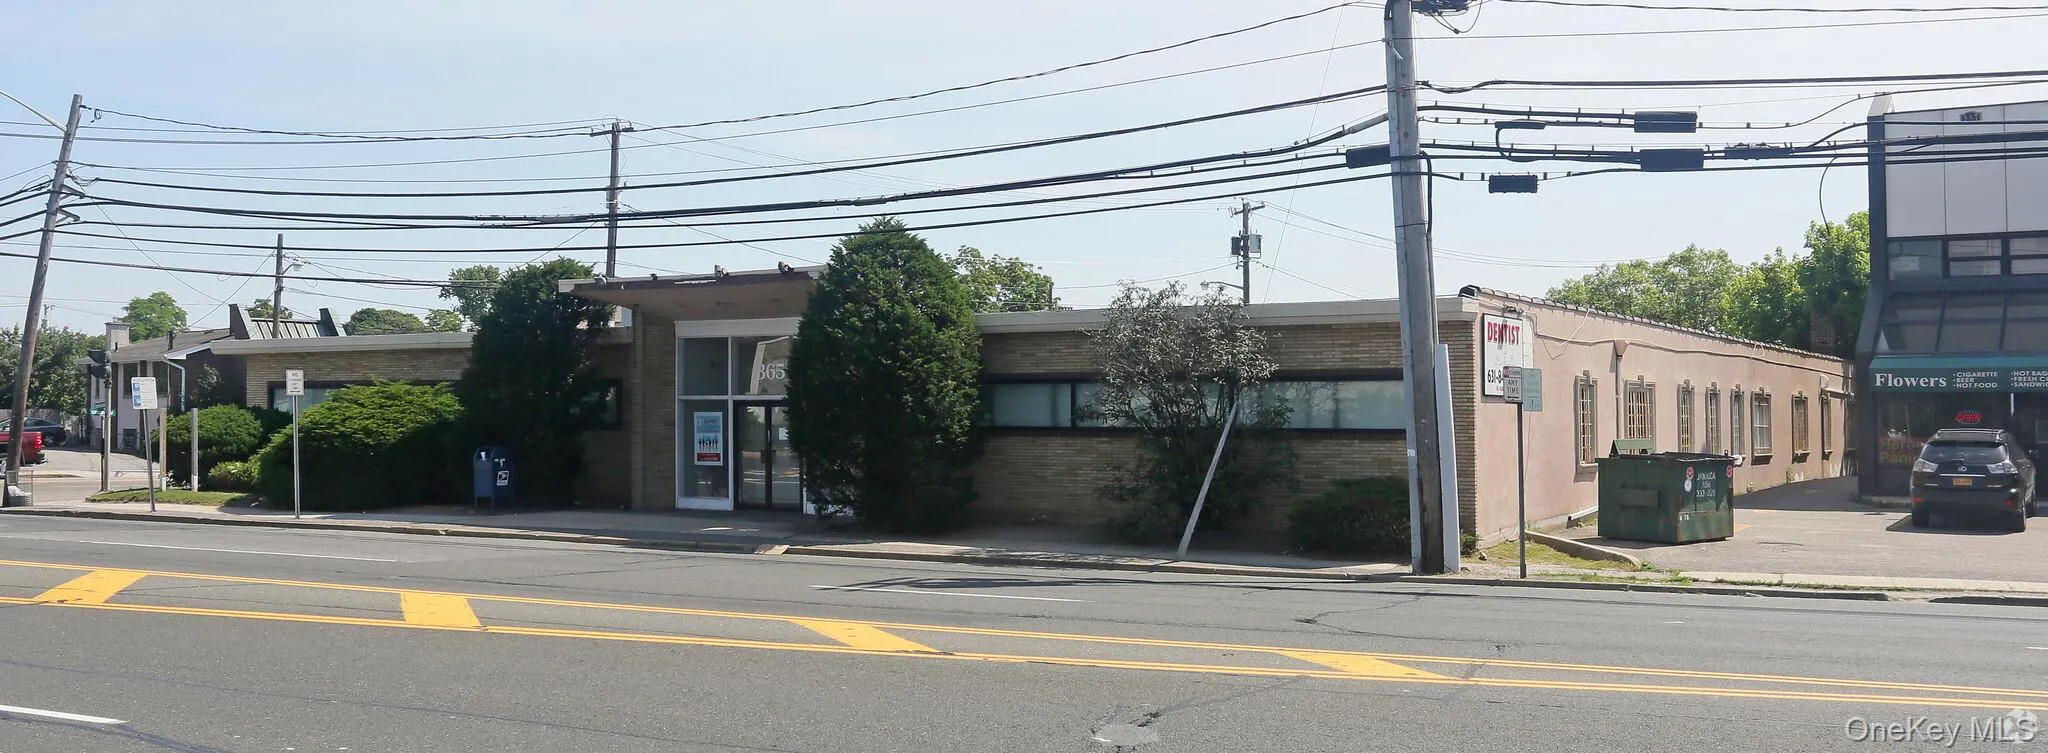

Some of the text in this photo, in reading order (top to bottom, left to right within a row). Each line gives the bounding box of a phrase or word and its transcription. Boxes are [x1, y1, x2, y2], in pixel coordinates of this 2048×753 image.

[1487, 321, 1520, 345] DENTIST
[1507, 379, 1518, 387] ANY
[1874, 373, 1947, 387] Flowers
[1506, 386, 1520, 394] TIME
